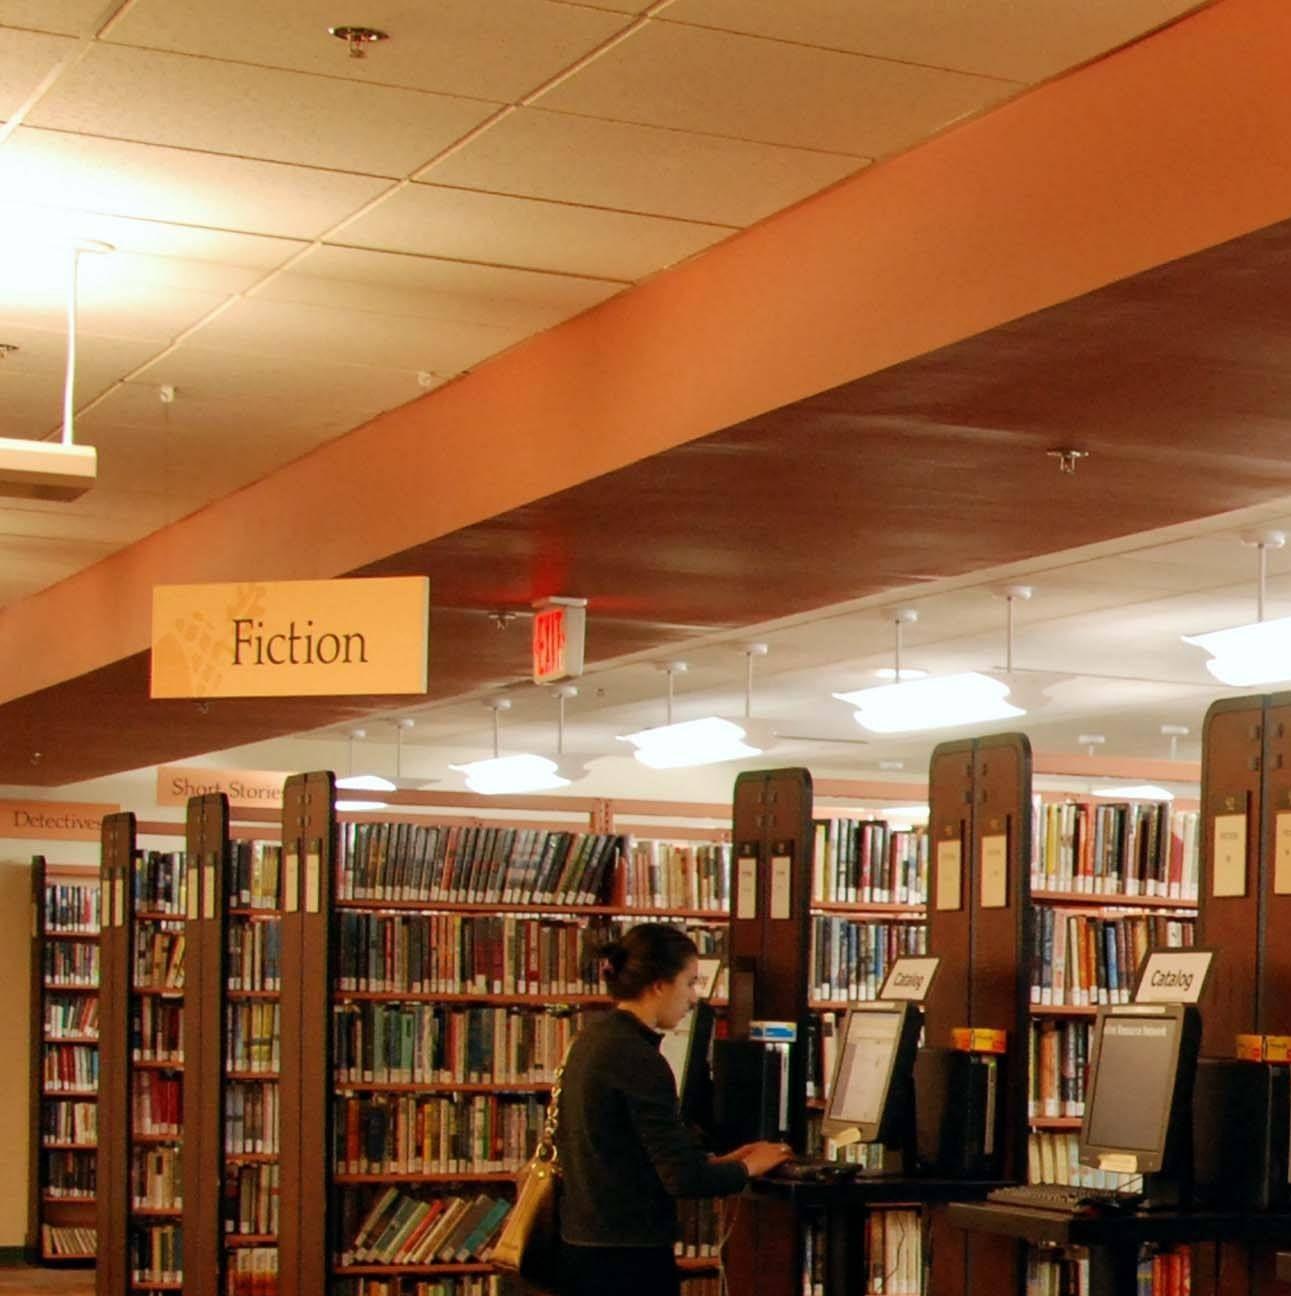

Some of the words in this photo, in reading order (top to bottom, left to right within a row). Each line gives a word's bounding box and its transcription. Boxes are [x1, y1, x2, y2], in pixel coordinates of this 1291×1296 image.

[232, 618, 369, 666] Fiction
[172, 776, 221, 796] Short
[229, 780, 284, 801] Storie
[893, 971, 925, 991] Catalog
[1151, 969, 1195, 991] Catalog
